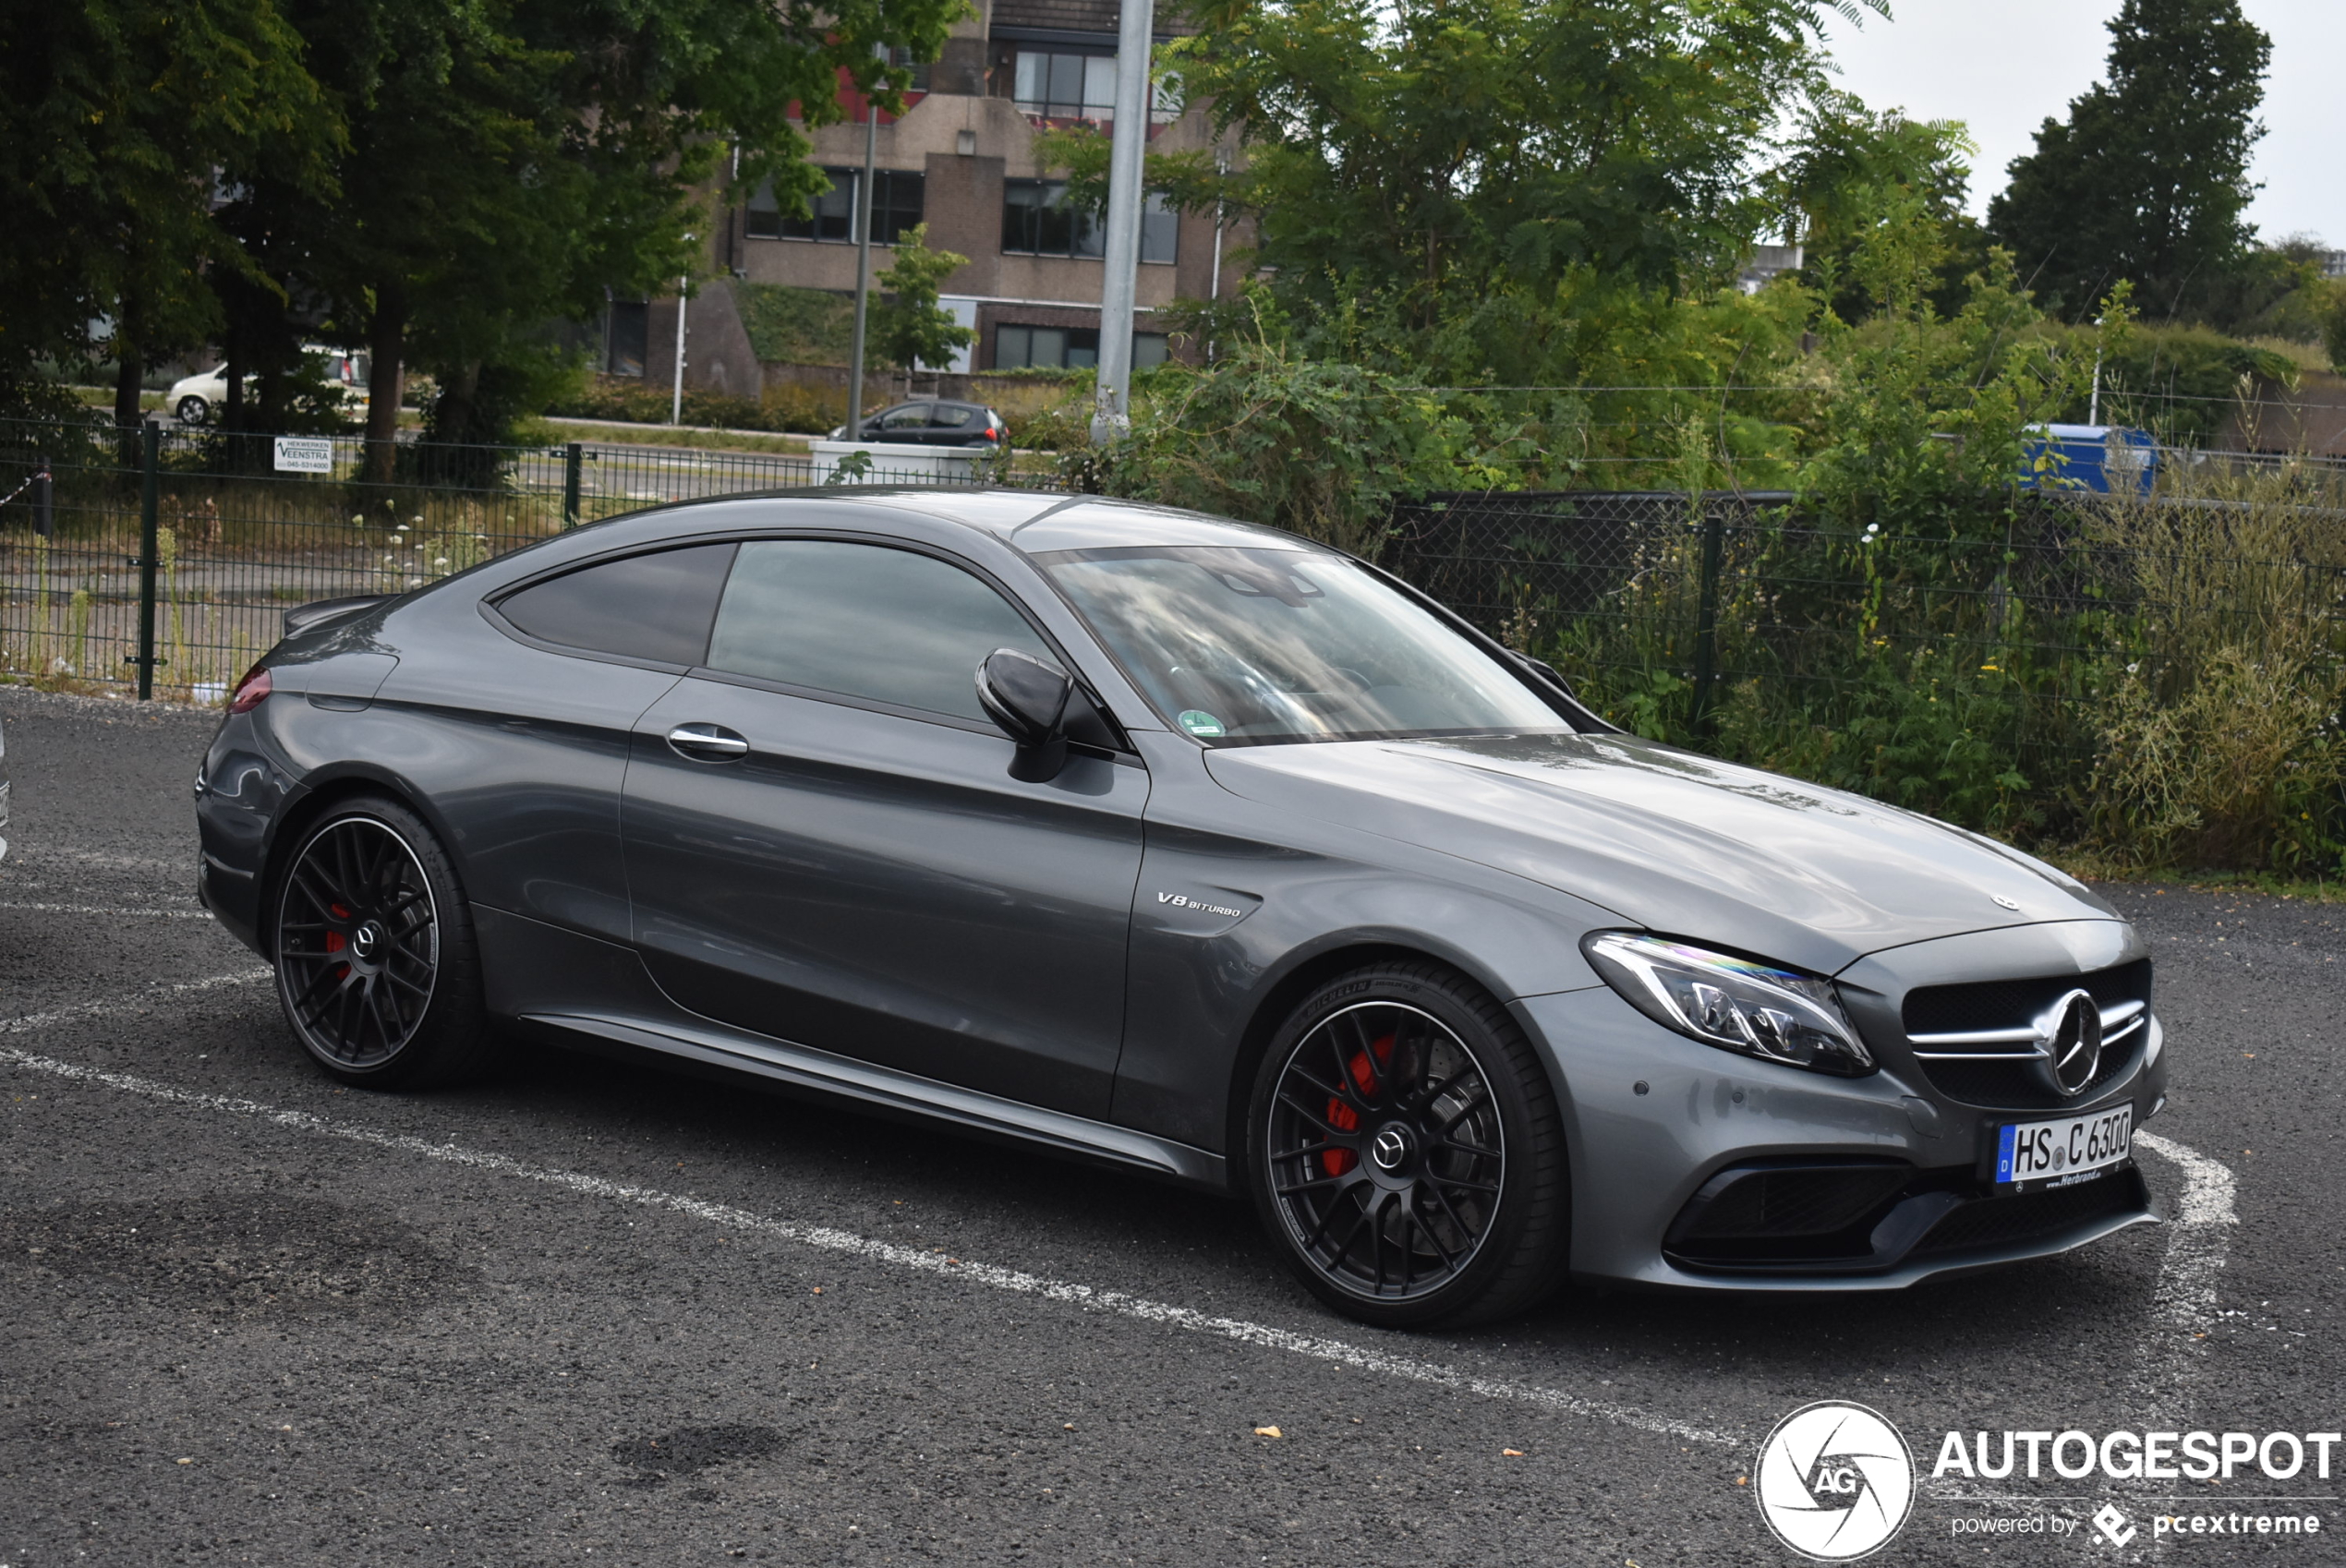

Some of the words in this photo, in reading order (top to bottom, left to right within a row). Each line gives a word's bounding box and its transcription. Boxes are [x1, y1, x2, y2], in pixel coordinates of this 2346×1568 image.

[277, 444, 328, 460] VEENSTRA
[287, 440, 329, 449] HEKWERKEN
[1158, 892, 1187, 907] V8
[1189, 901, 1240, 917] BITURBO
[1306, 982, 1369, 1017] MICHELIN
[2014, 1127, 2052, 1174] HS
[2068, 1122, 2084, 1166] C
[2086, 1111, 2130, 1163] 6300
[2001, 1159, 2009, 1173] D
